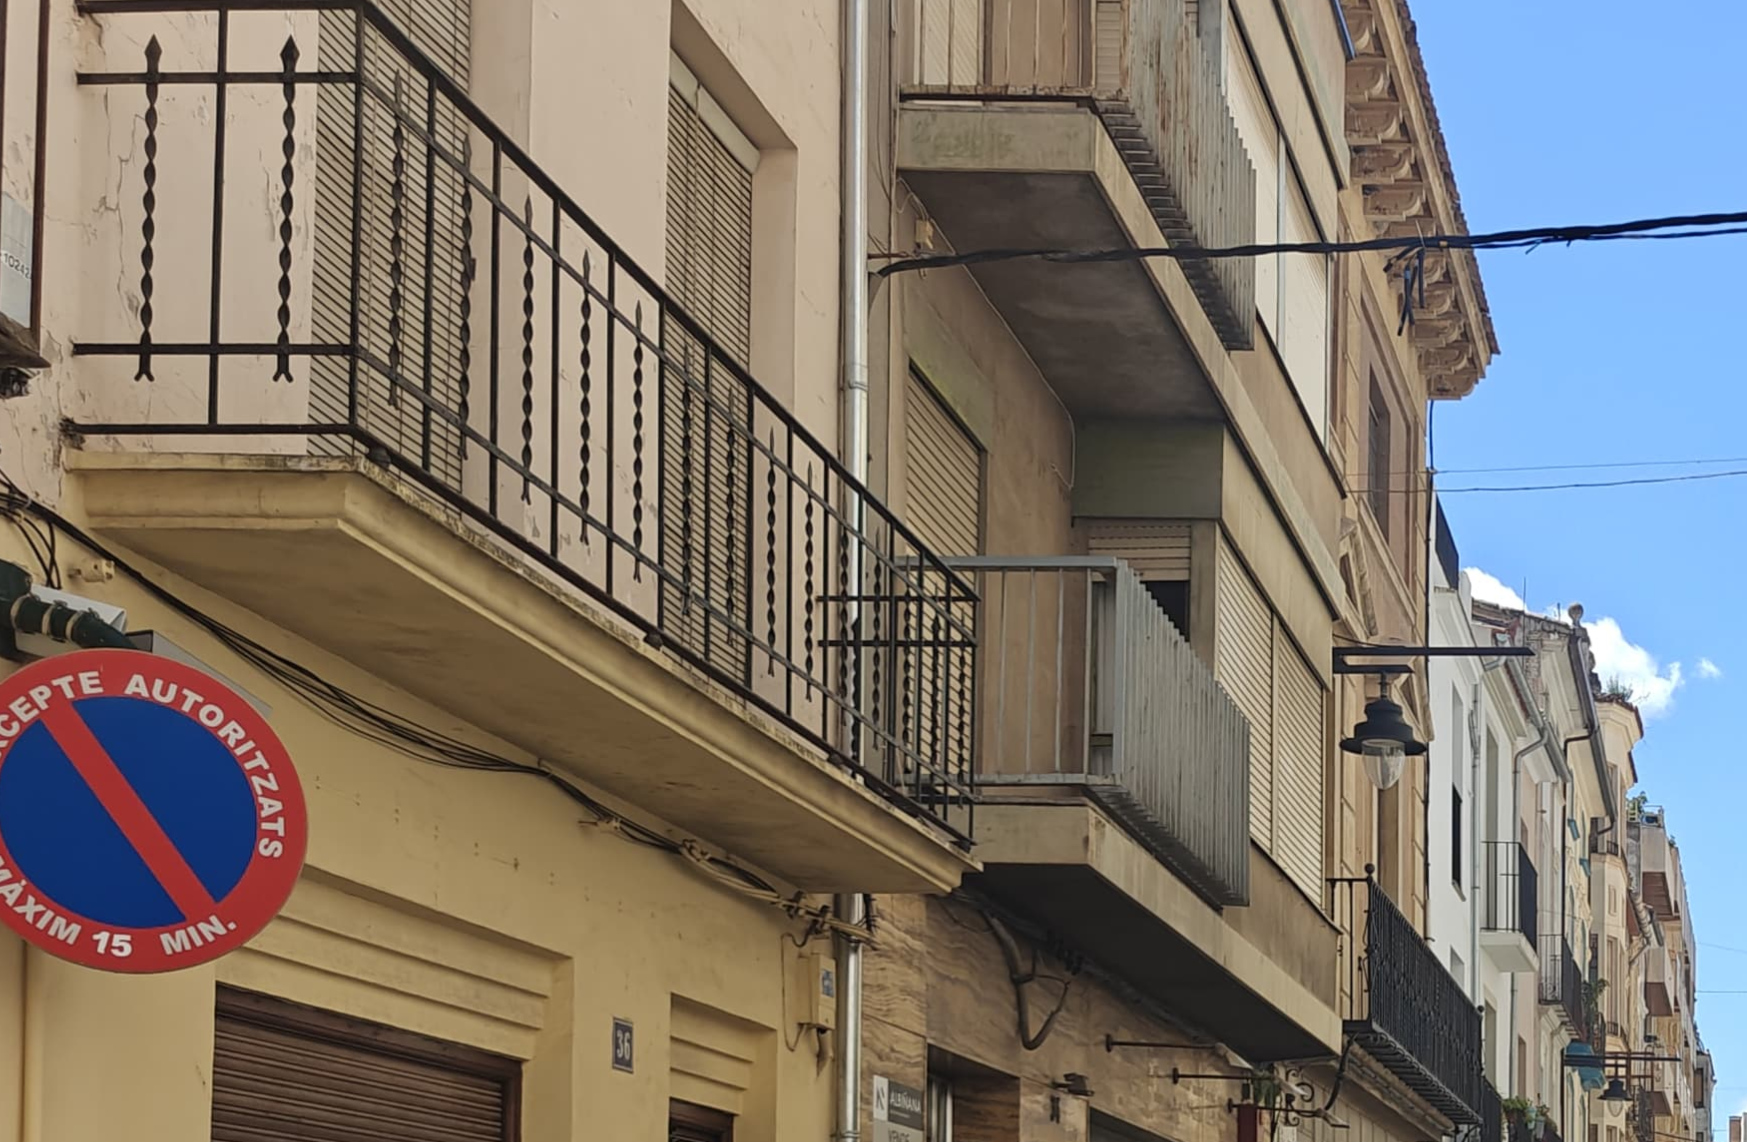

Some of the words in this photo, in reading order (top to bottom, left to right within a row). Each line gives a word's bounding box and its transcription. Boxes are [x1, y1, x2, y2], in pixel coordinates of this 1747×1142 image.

[0, 671, 104, 758] CEPTE
[124, 673, 285, 859] AUTORITZATS
[92, 931, 133, 958] 15
[159, 914, 238, 956] MIN.
[616, 1029, 631, 1061] 36
